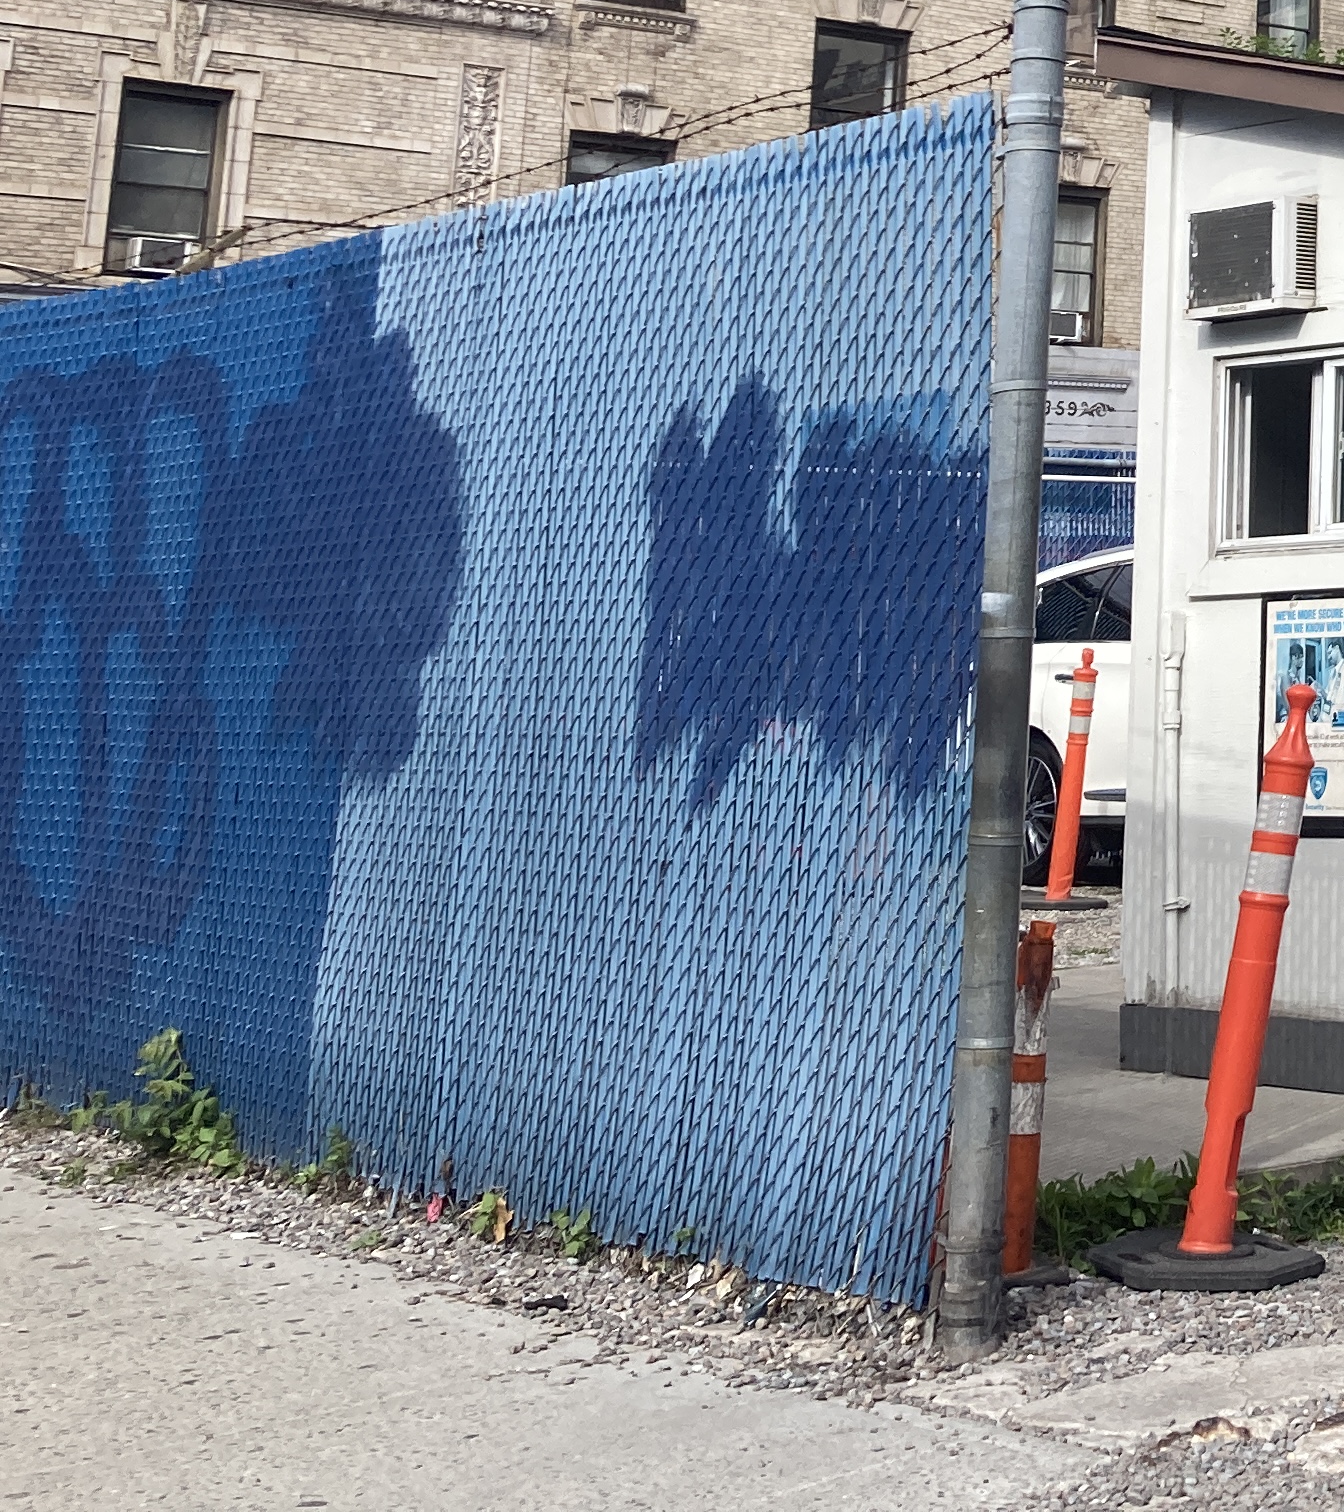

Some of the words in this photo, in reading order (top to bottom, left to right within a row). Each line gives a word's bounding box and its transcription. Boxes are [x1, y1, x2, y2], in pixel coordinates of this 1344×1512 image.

[1276, 610, 1296, 621] WE'RE
[1298, 609, 1317, 620] MORE
[1318, 608, 1344, 619] SECURE
[1273, 623, 1293, 633] WHEN
[1293, 623, 1304, 633] WE
[1305, 622, 1325, 632] KNOW
[1326, 621, 1341, 632] WHO
